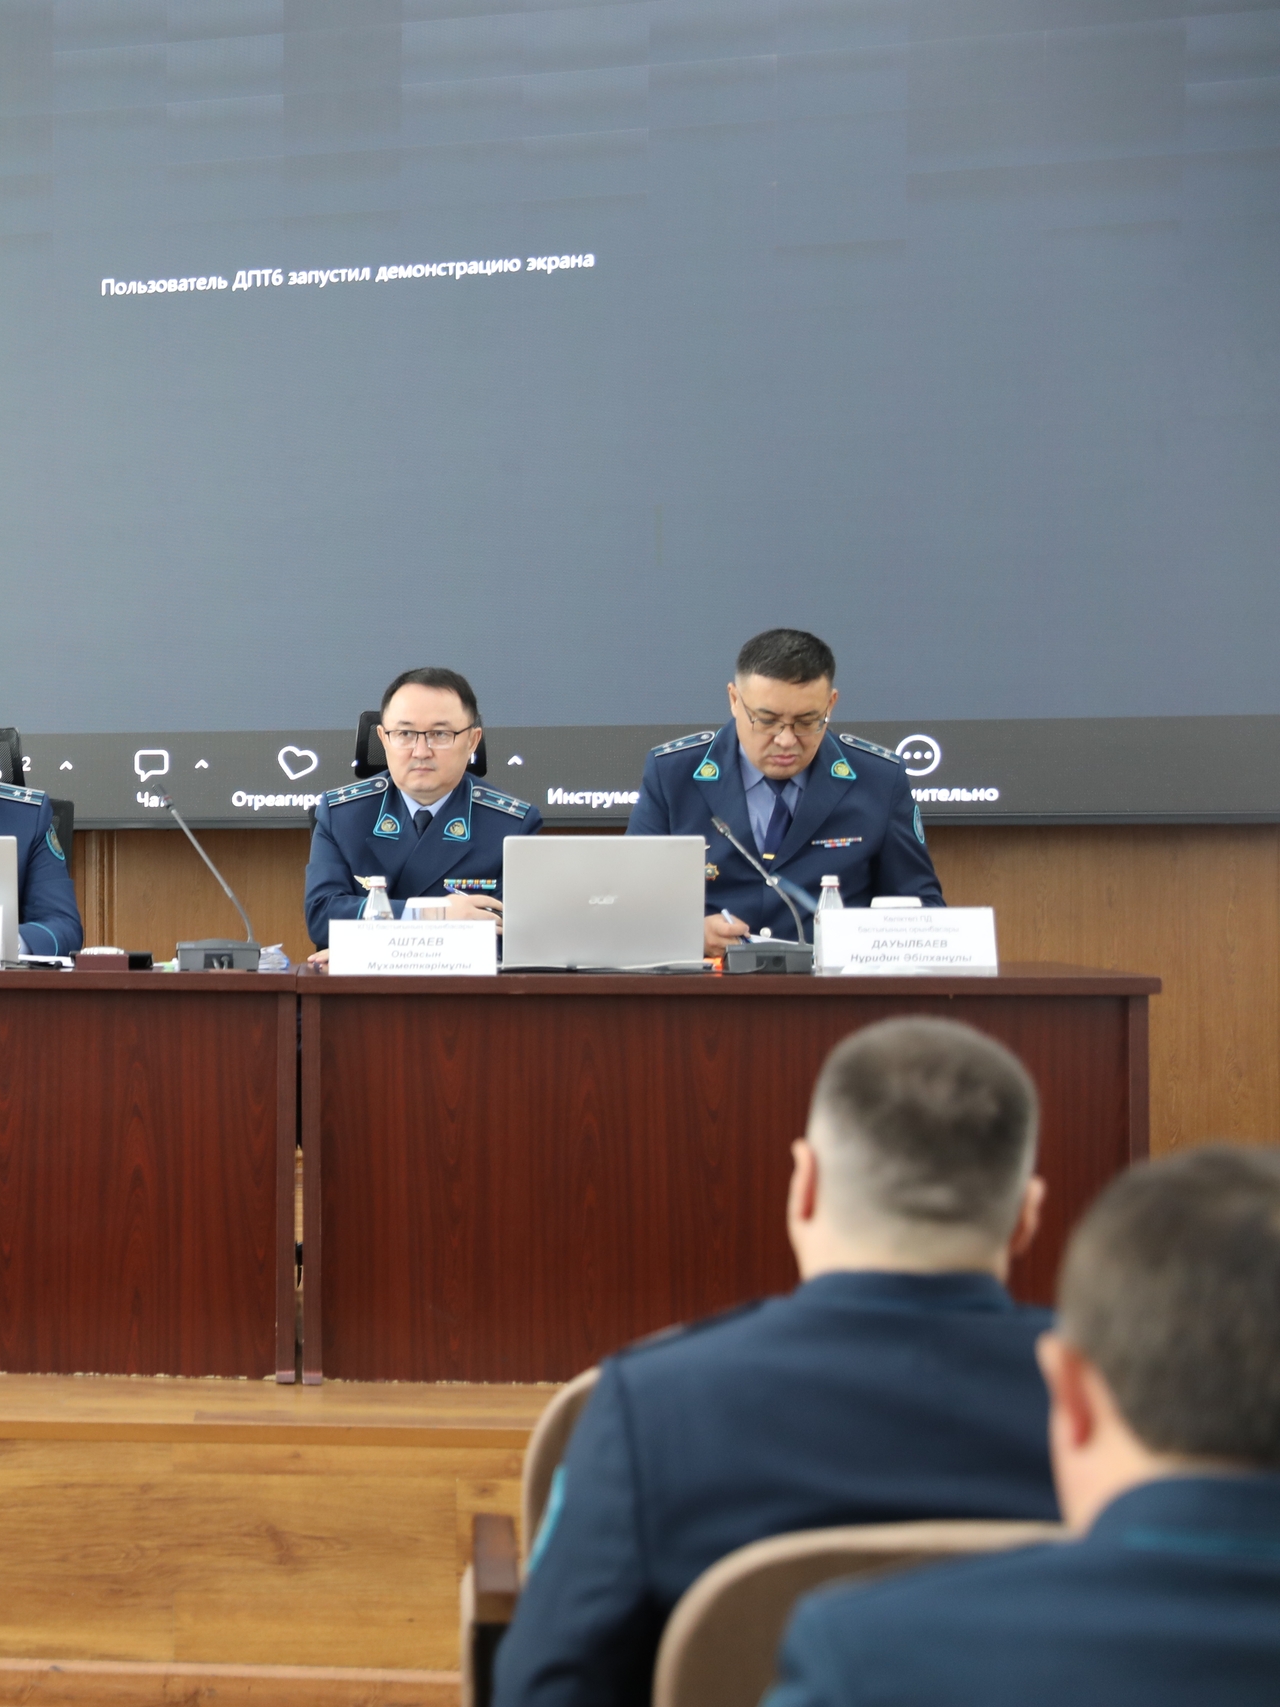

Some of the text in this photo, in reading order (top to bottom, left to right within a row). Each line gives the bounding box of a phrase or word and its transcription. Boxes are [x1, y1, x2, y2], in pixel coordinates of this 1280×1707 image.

[101, 253, 595, 296] Пользователь ДПТ6 запустил демонстрацию экрана
[21, 756, 32, 772] 2
[136, 791, 166, 808] Ча
[387, 937, 445, 947] АШТАЕВ
[871, 939, 949, 950] ДАУЫЛБАЕВ
